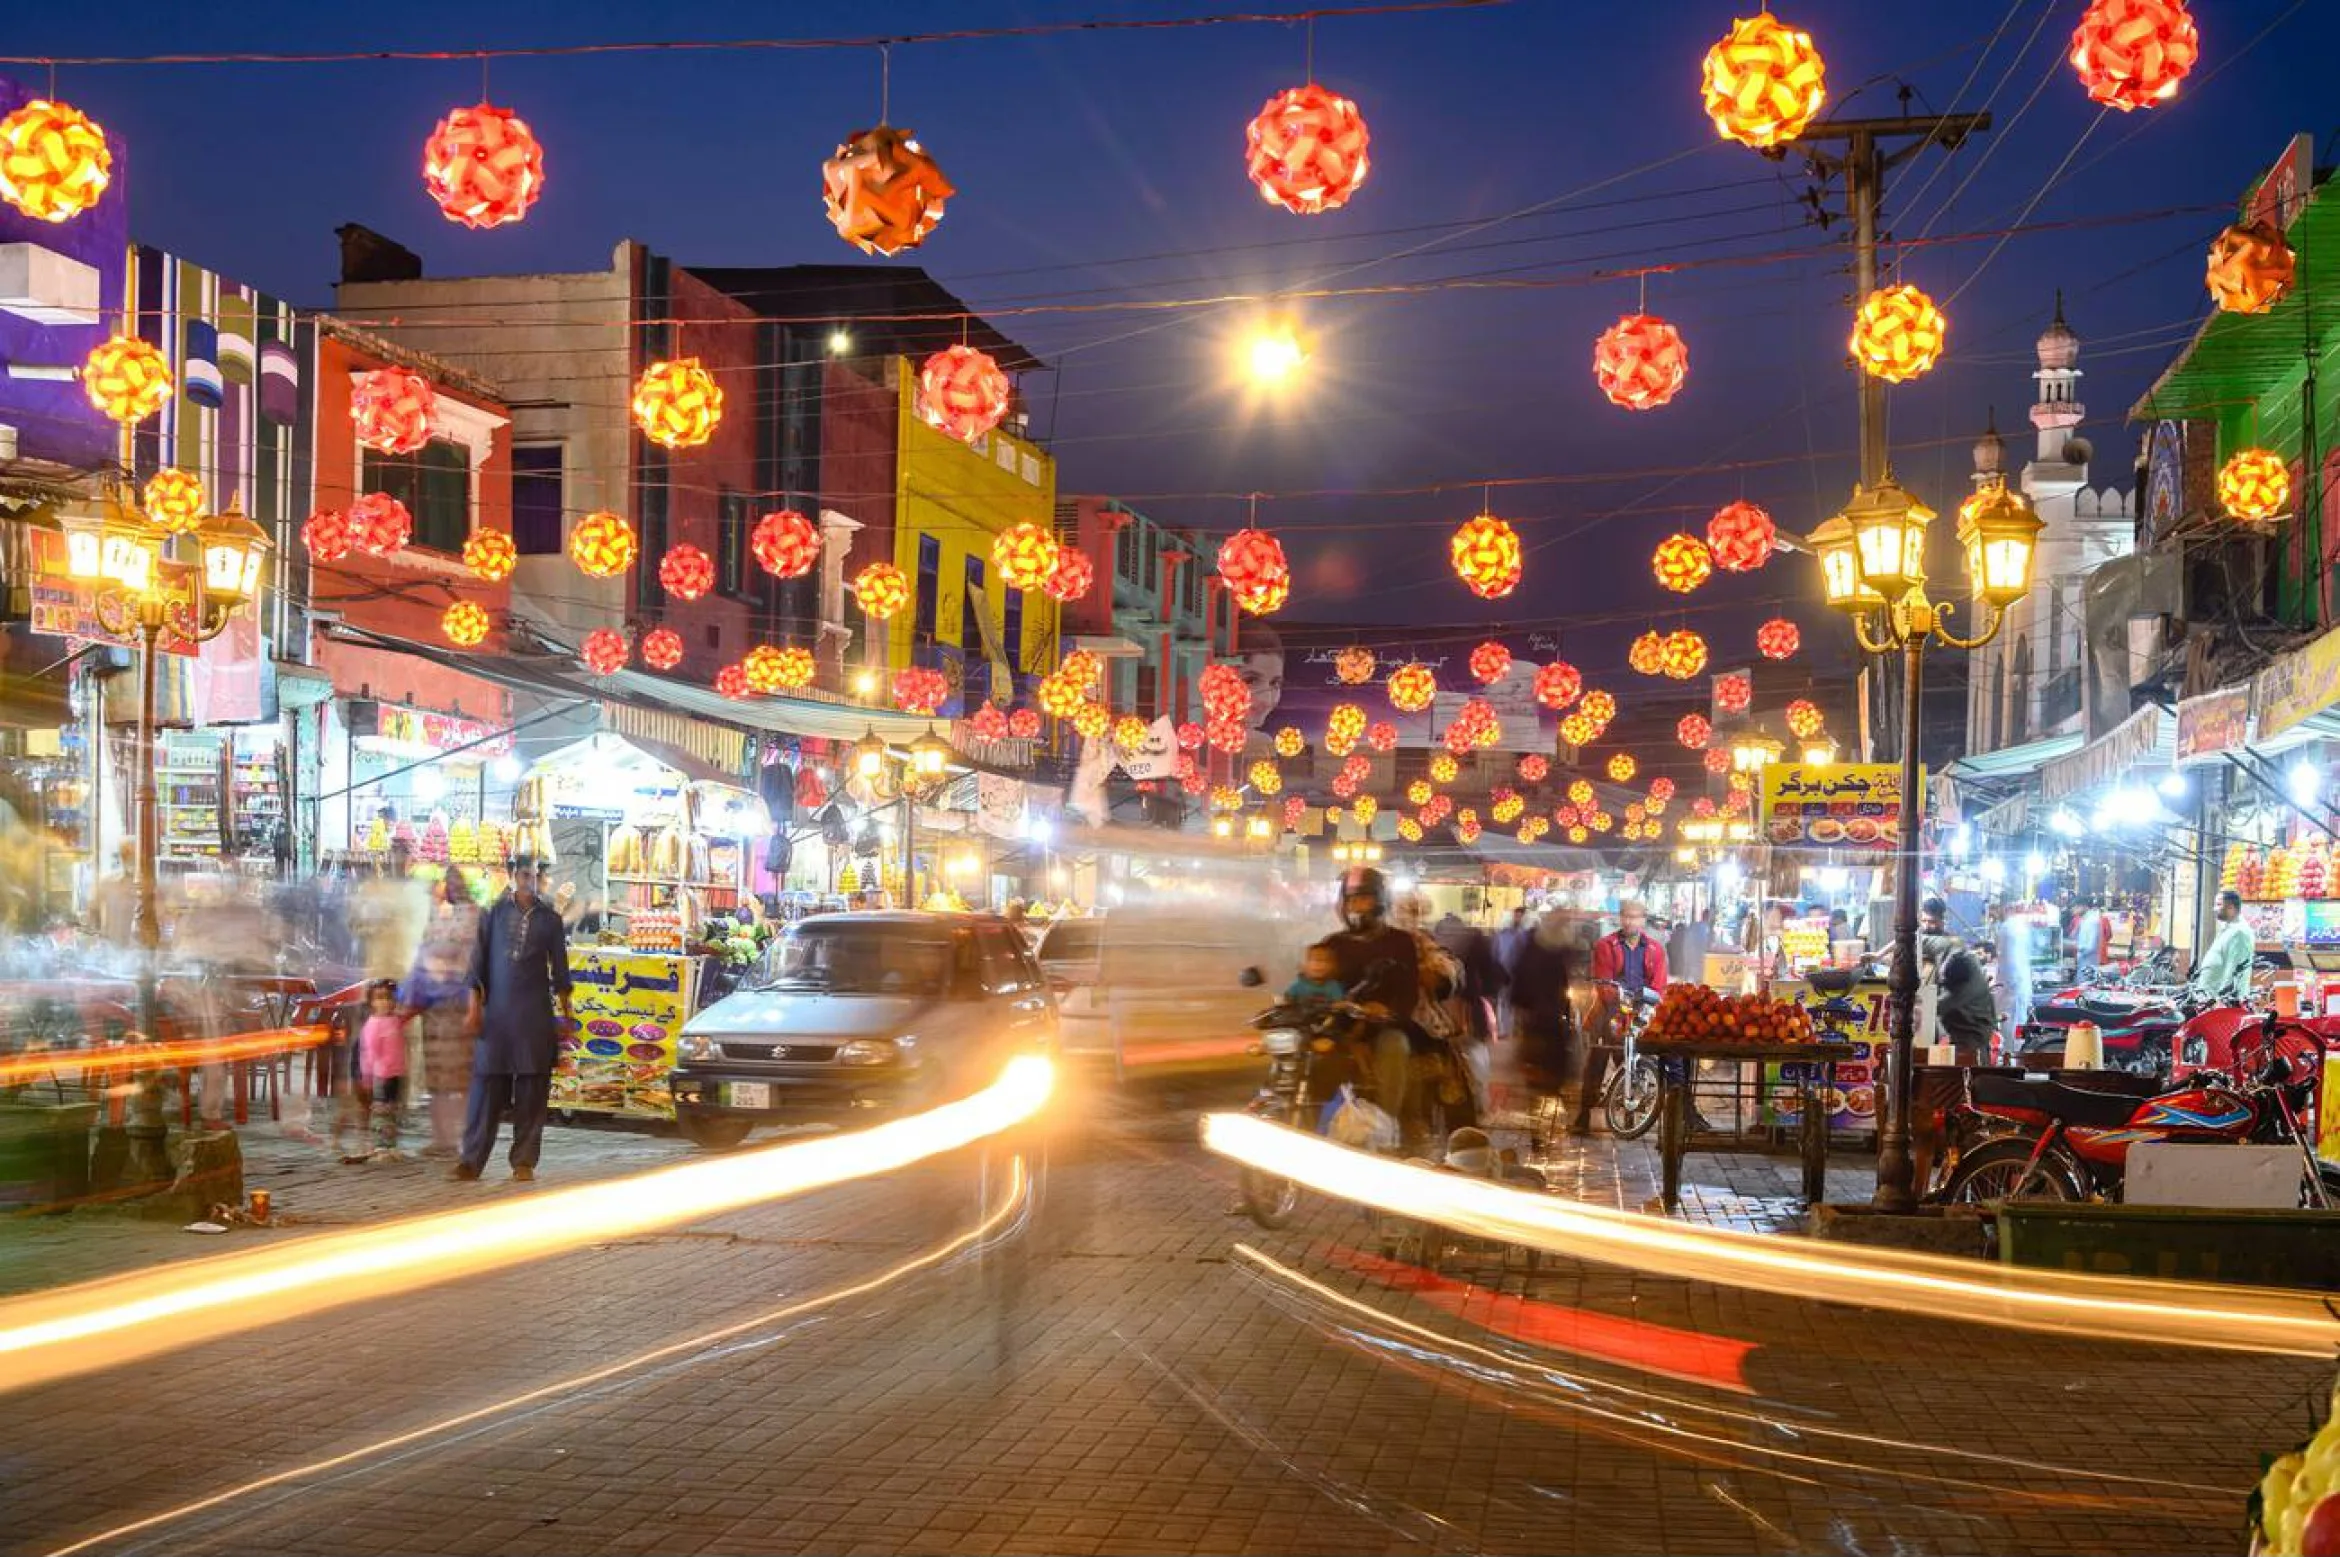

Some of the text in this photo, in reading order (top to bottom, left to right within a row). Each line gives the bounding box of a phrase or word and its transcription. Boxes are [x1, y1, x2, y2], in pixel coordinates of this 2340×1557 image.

[1775, 770, 1821, 796] برگر
[1821, 773, 1870, 799] چکن
[569, 955, 679, 995] قریش
